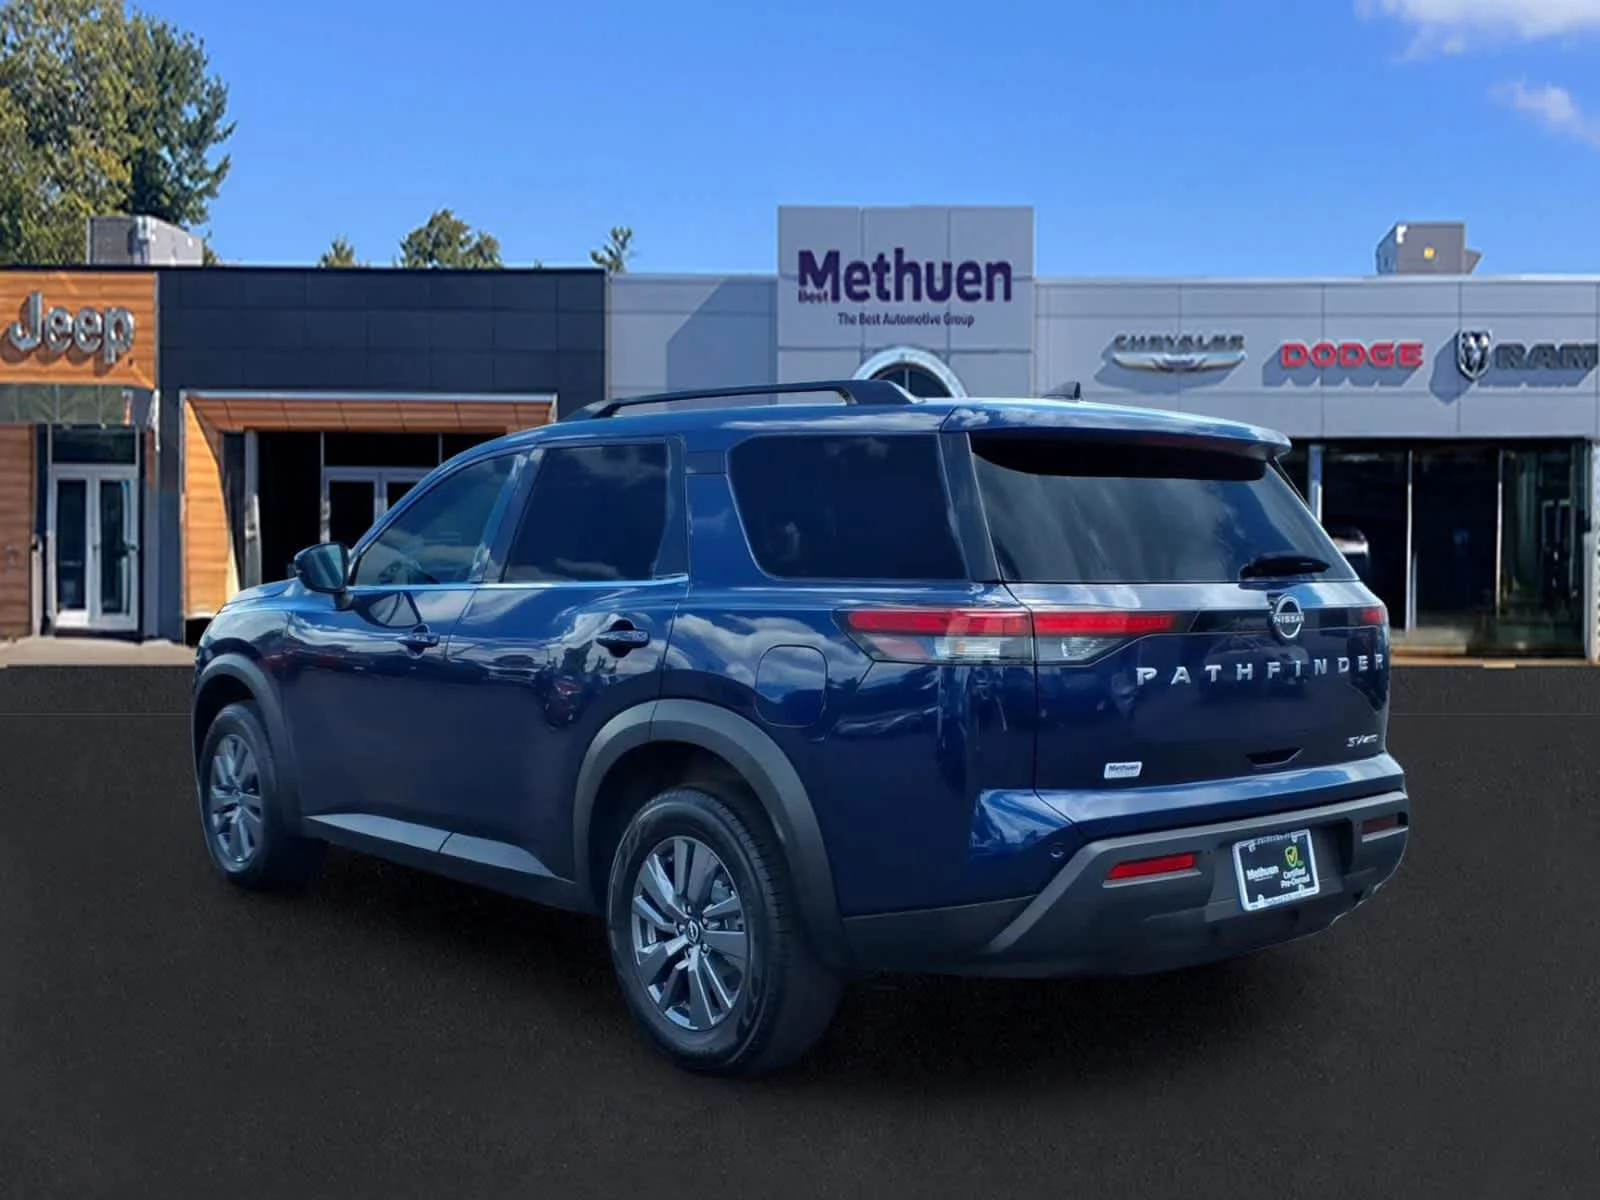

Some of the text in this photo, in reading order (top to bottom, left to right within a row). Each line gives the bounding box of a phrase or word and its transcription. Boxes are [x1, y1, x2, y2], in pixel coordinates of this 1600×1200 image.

[798, 247, 1012, 303] Methuen
[9, 290, 135, 364] Jeep
[838, 311, 975, 328] The Best Automotive Group
[1114, 334, 1244, 352] CHRYSLER
[1282, 342, 1424, 368] DODGE
[1494, 343, 1598, 370] RAM
[1273, 612, 1304, 624] NISSAN
[1136, 653, 1384, 686] PATHFINDER
